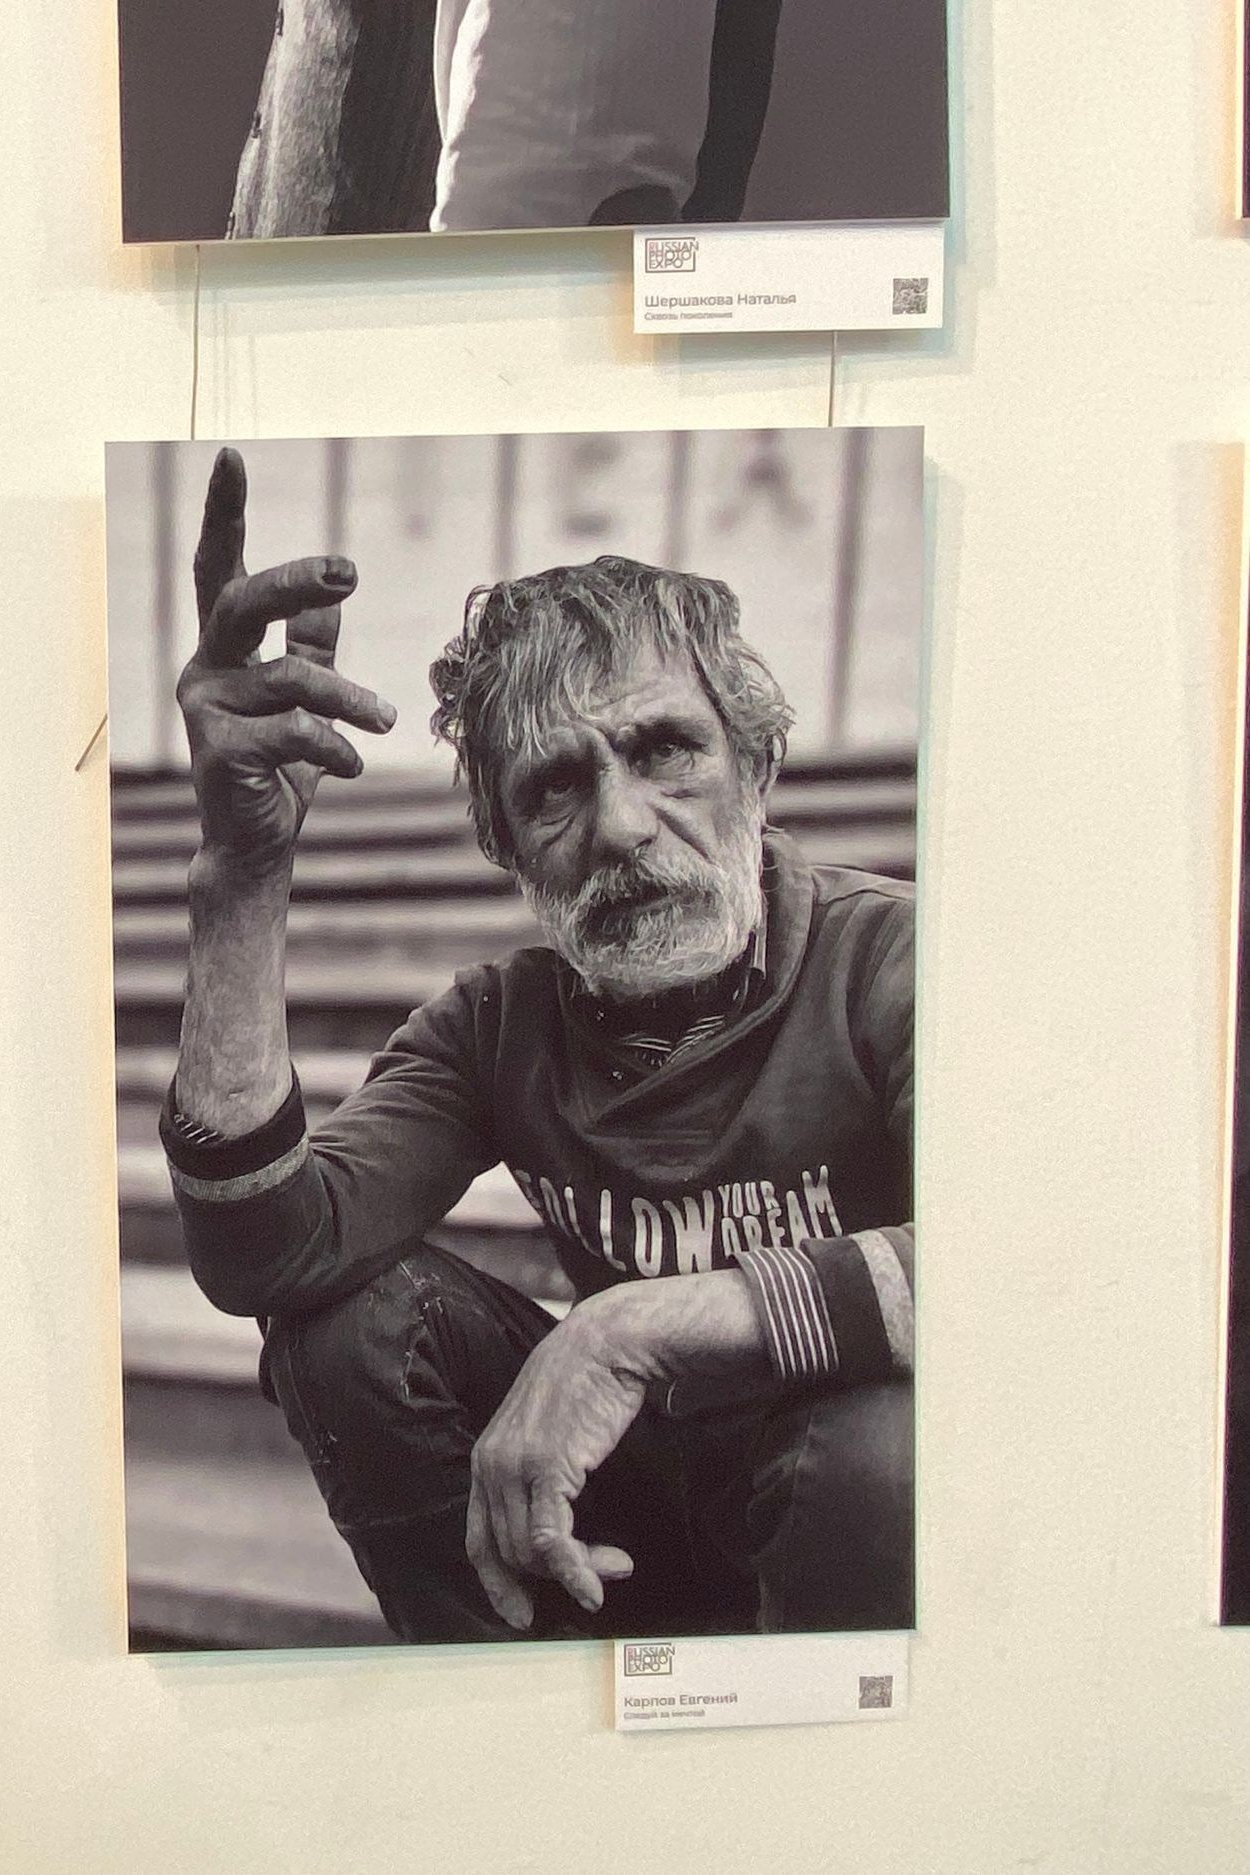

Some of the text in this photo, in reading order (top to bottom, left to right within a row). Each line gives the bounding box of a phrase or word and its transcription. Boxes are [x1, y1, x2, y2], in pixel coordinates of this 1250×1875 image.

[648, 241, 699, 252] RUSSIAN
[649, 250, 692, 261] PHOTO
[649, 259, 683, 269] EXPO
[644, 293, 797, 309] Шершакова Наталья
[717, 1180, 780, 1218] YOUR
[721, 1164, 843, 1260] DREAM
[627, 1646, 675, 1656] RUSSIAN
[628, 1654, 668, 1665] PHOTO
[628, 1662, 660, 1672] EXPO
[624, 1692, 738, 1710] Карпов Евгений
